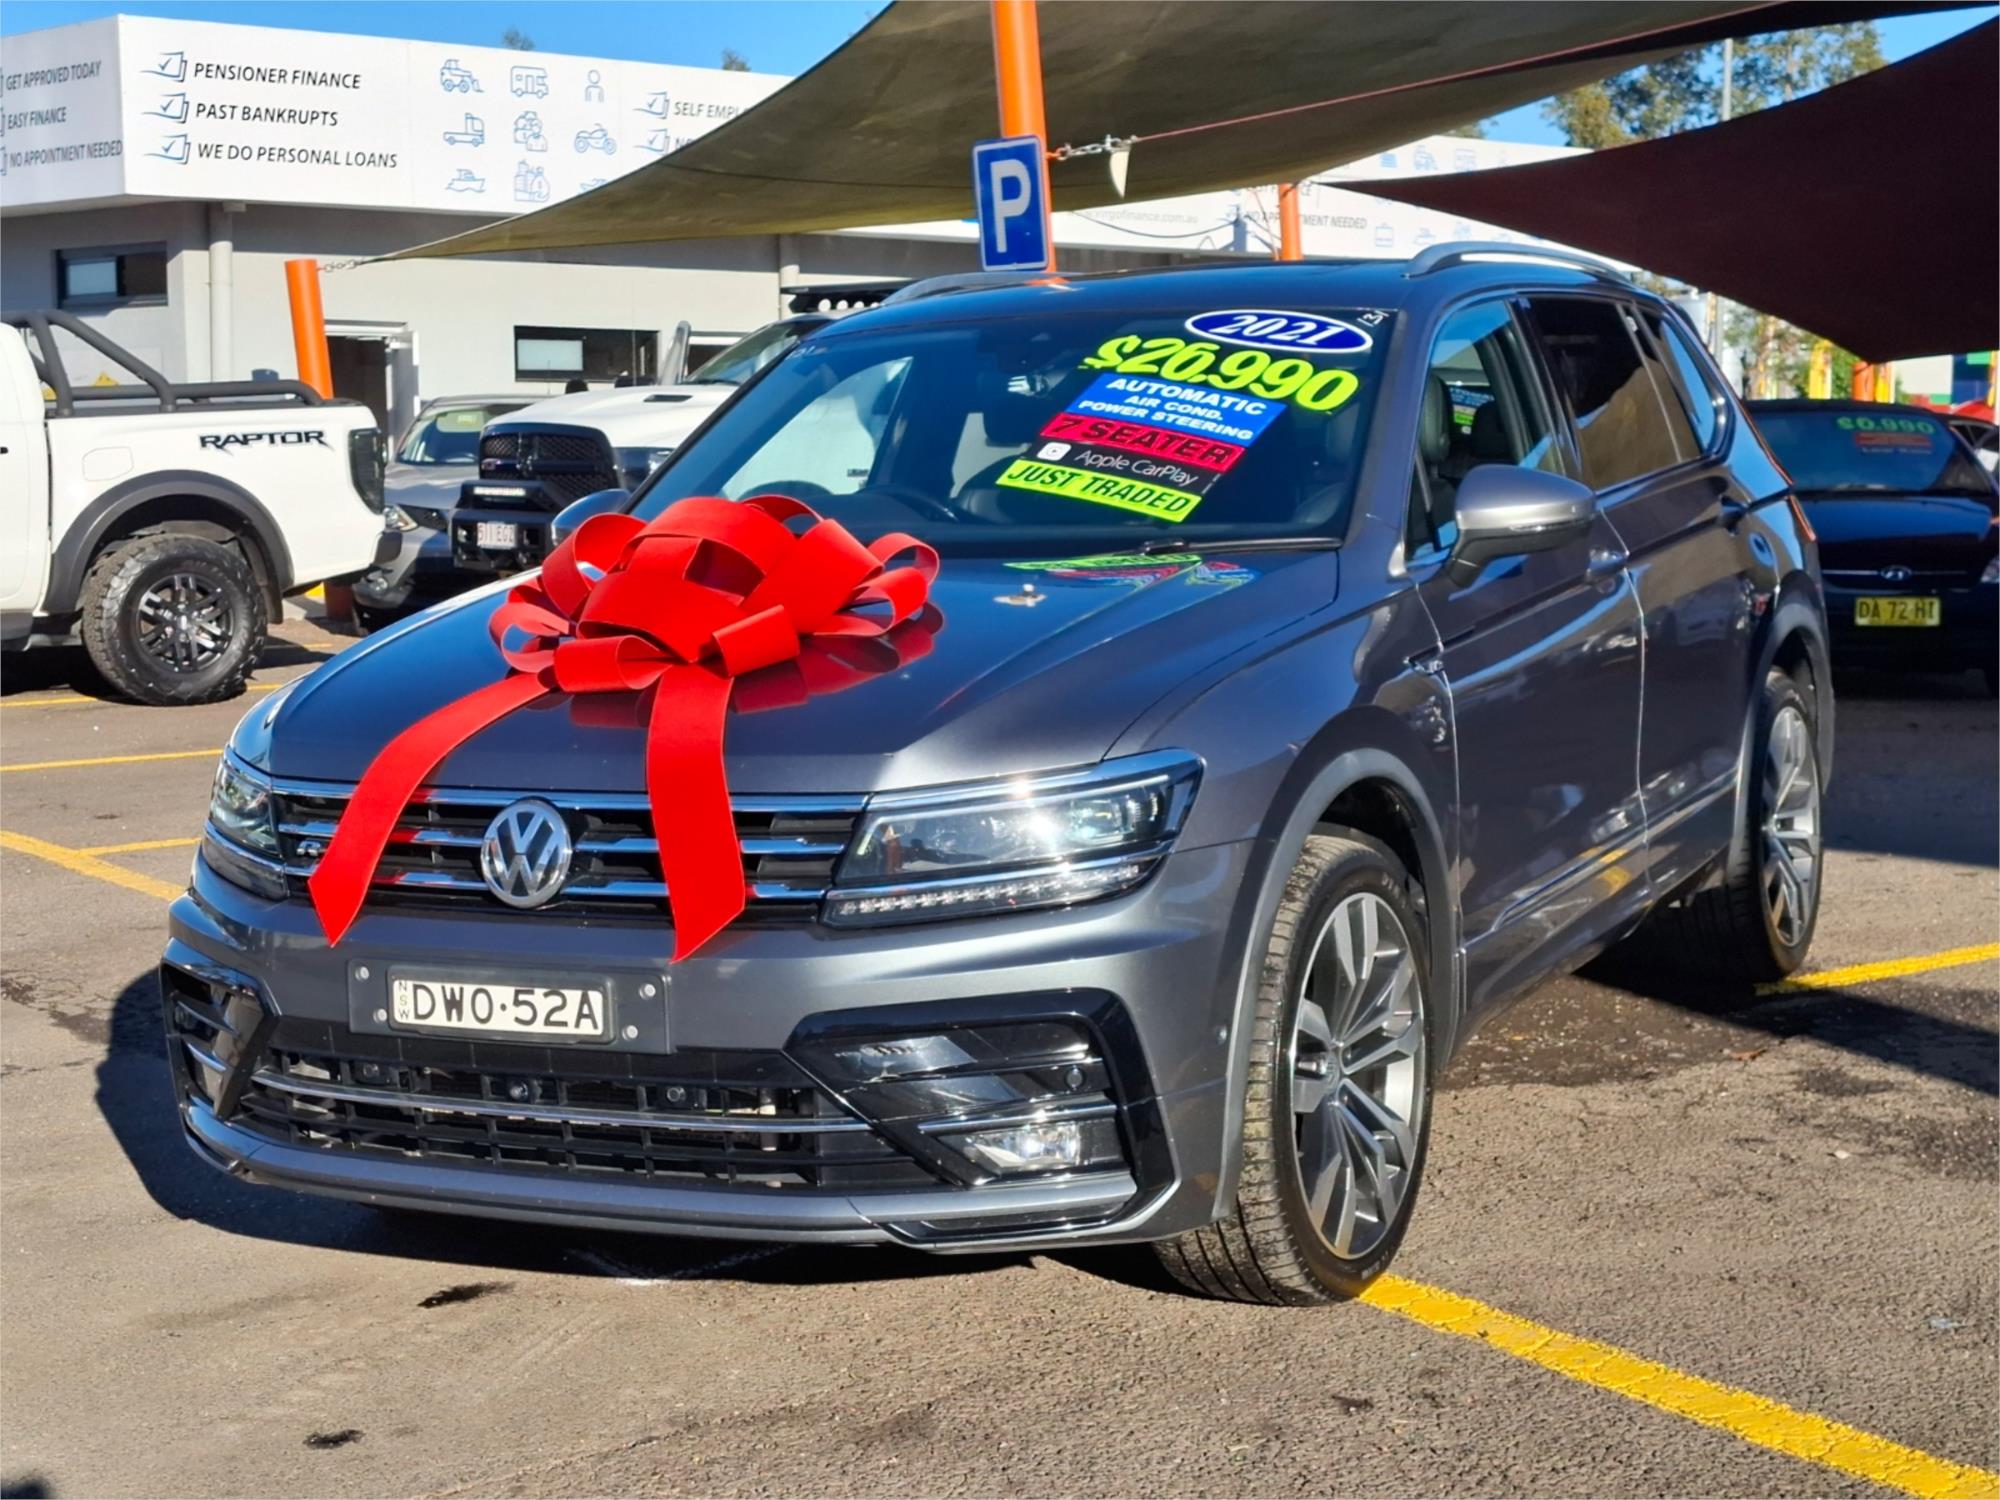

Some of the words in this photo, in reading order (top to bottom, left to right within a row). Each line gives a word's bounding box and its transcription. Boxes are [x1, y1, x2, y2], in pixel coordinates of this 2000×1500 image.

[6, 73, 22, 91] GET
[23, 65, 70, 89] APPROVED
[71, 60, 102, 81] TODAY
[194, 62, 288, 84] PENSIONER
[292, 69, 362, 89] FINANCE
[8, 112, 28, 130] EASY
[30, 106, 67, 127] FINANCE
[196, 103, 238, 120] PAST
[241, 105, 338, 127] BANKRUPTS
[674, 101, 704, 117] SELF
[706, 104, 750, 119] EMPL
[10, 152, 22, 168] NO
[24, 144, 85, 166] APPOINTMENT
[86, 139, 123, 159] NEEDED
[198, 143, 223, 160] WE
[227, 144, 253, 161] DO
[257, 146, 341, 166] PERSONAL
[345, 151, 398, 169] LOANS
[990, 159, 1032, 253] P
[1331, 216, 1367, 230] NEEDED
[1208, 315, 1347, 345] 2021
[1080, 334, 1359, 411] $26.990
[1106, 378, 1267, 416] AUTOMATIC
[1124, 395, 1160, 409] AIR
[1163, 400, 1223, 422] COND.
[1078, 400, 1147, 418] POWER
[1151, 405, 1255, 440] STEERING
[200, 430, 334, 455] RAPTOR
[1052, 418, 1078, 434] 7
[1081, 421, 1234, 466] SEATER
[1074, 449, 1129, 471] Apple
[1131, 458, 1199, 487] CarPlay
[1007, 464, 1082, 488] JUST
[1081, 476, 1191, 513] TRADED
[1887, 601, 1908, 620] 72
